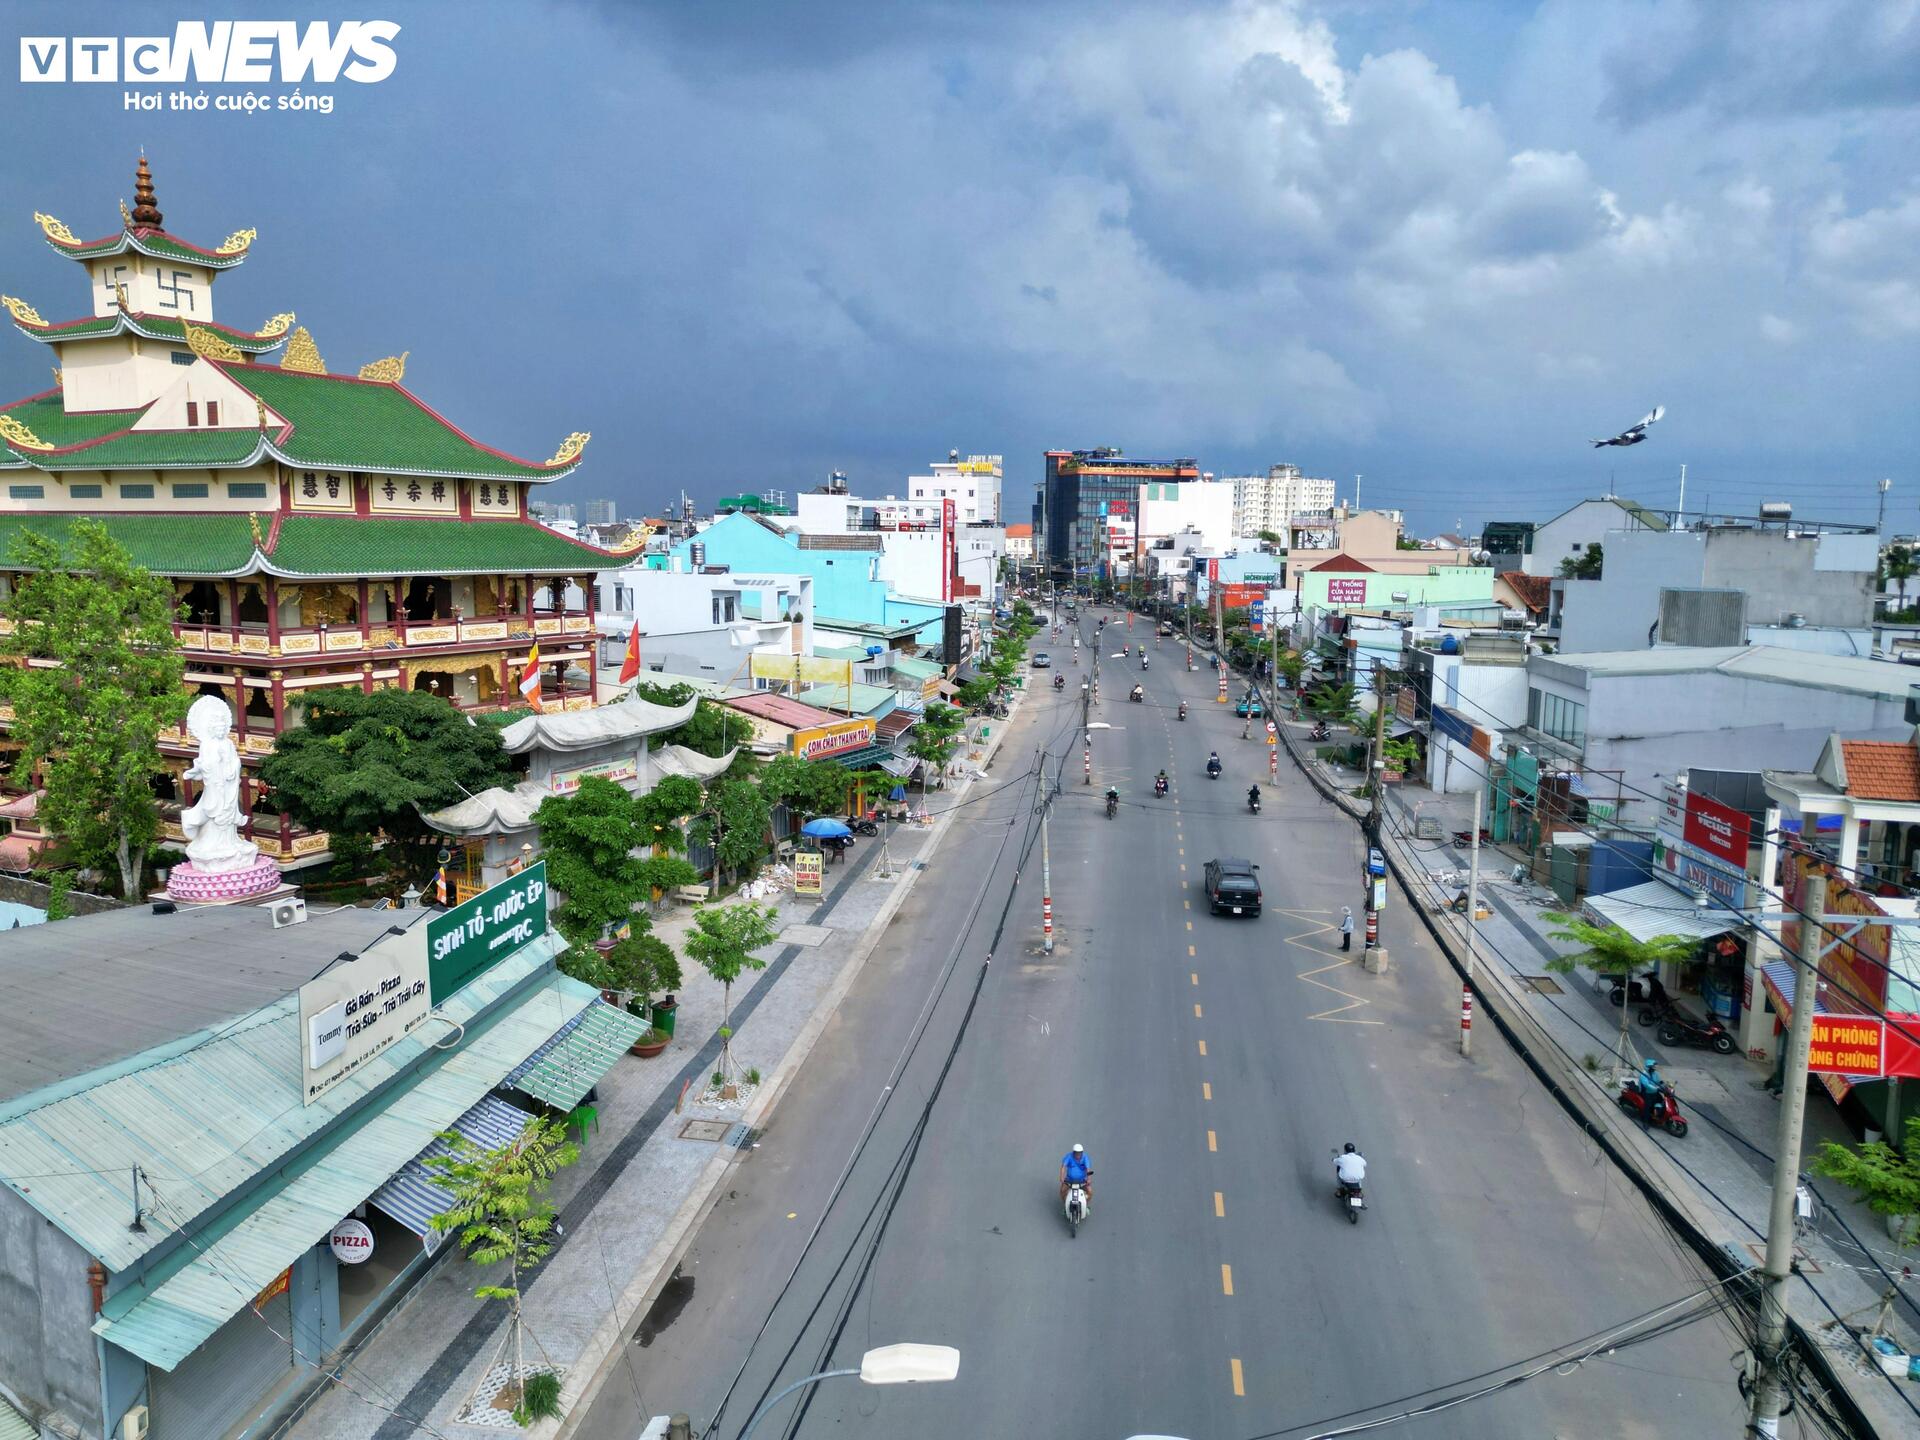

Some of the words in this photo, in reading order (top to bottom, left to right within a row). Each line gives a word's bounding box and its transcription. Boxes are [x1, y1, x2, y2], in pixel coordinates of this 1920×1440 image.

[839, 730, 857, 747] THANH
[380, 975, 401, 993] Pizza
[318, 1024, 343, 1046] Tommy
[1810, 1026, 1829, 1043] ĂN
[1832, 1025, 1878, 1046] PHÒNG
[1809, 1048, 1833, 1065] ÔNG
[1836, 1050, 1878, 1069] CHỨNG
[333, 1236, 370, 1247] PIZZA
